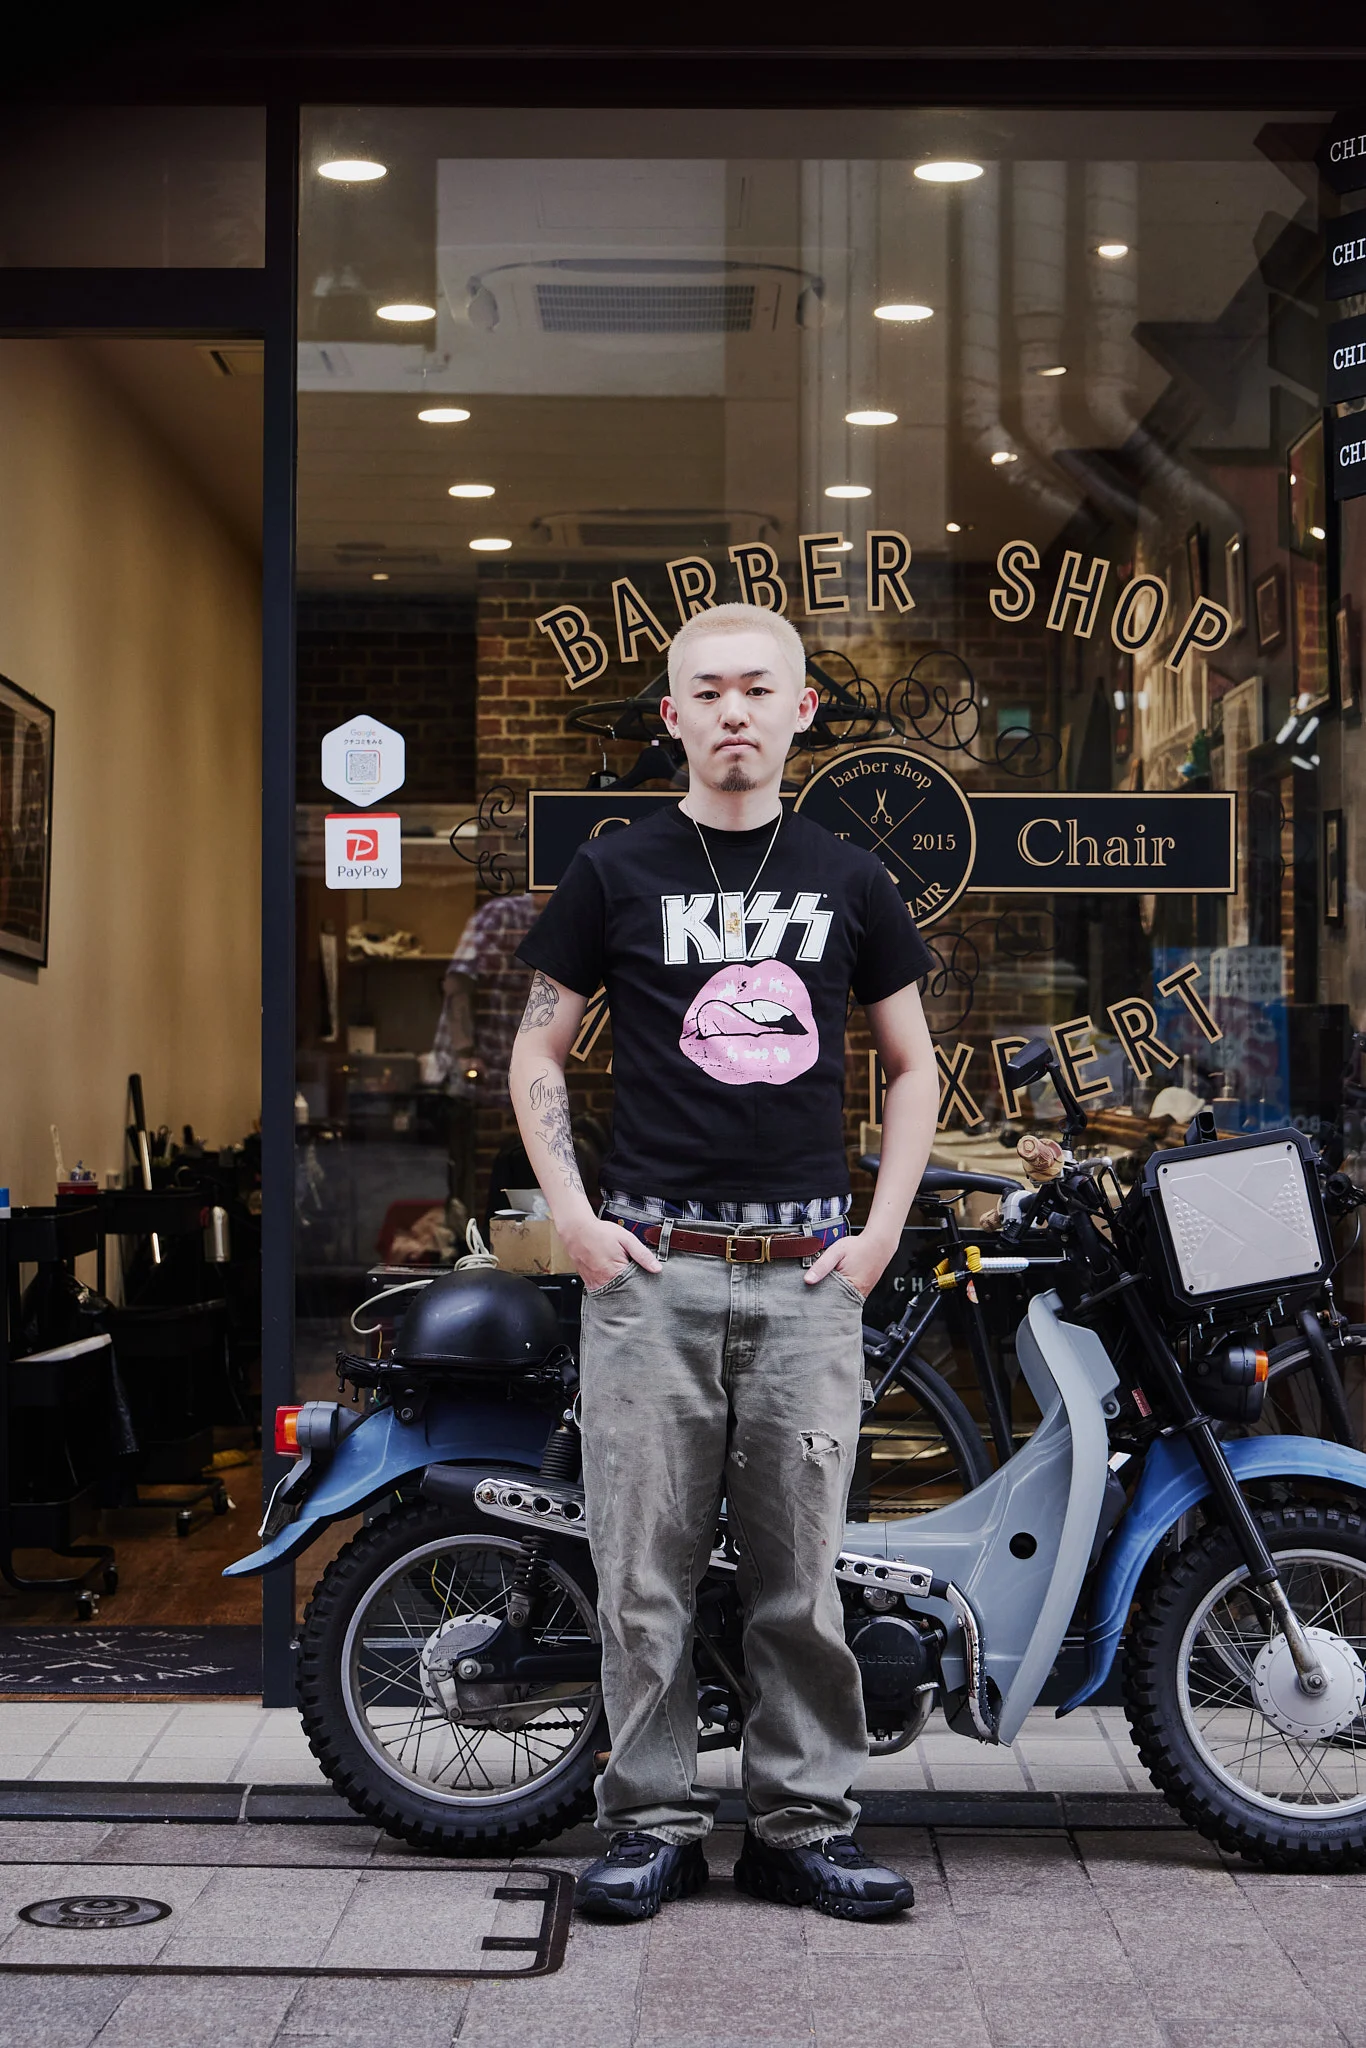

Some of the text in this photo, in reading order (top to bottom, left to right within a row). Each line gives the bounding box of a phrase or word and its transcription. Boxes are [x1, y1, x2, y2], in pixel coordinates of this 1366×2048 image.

[535, 530, 1233, 690] BARBER SHOP
[350, 729, 376, 738] Google
[828, 760, 933, 790] barber shop
[912, 833, 956, 851] 2015
[1017, 818, 1176, 867] Chair
[337, 865, 388, 879] PayPay
[661, 891, 835, 965] KISS
[856, 1654, 916, 1665] SUZUKI
